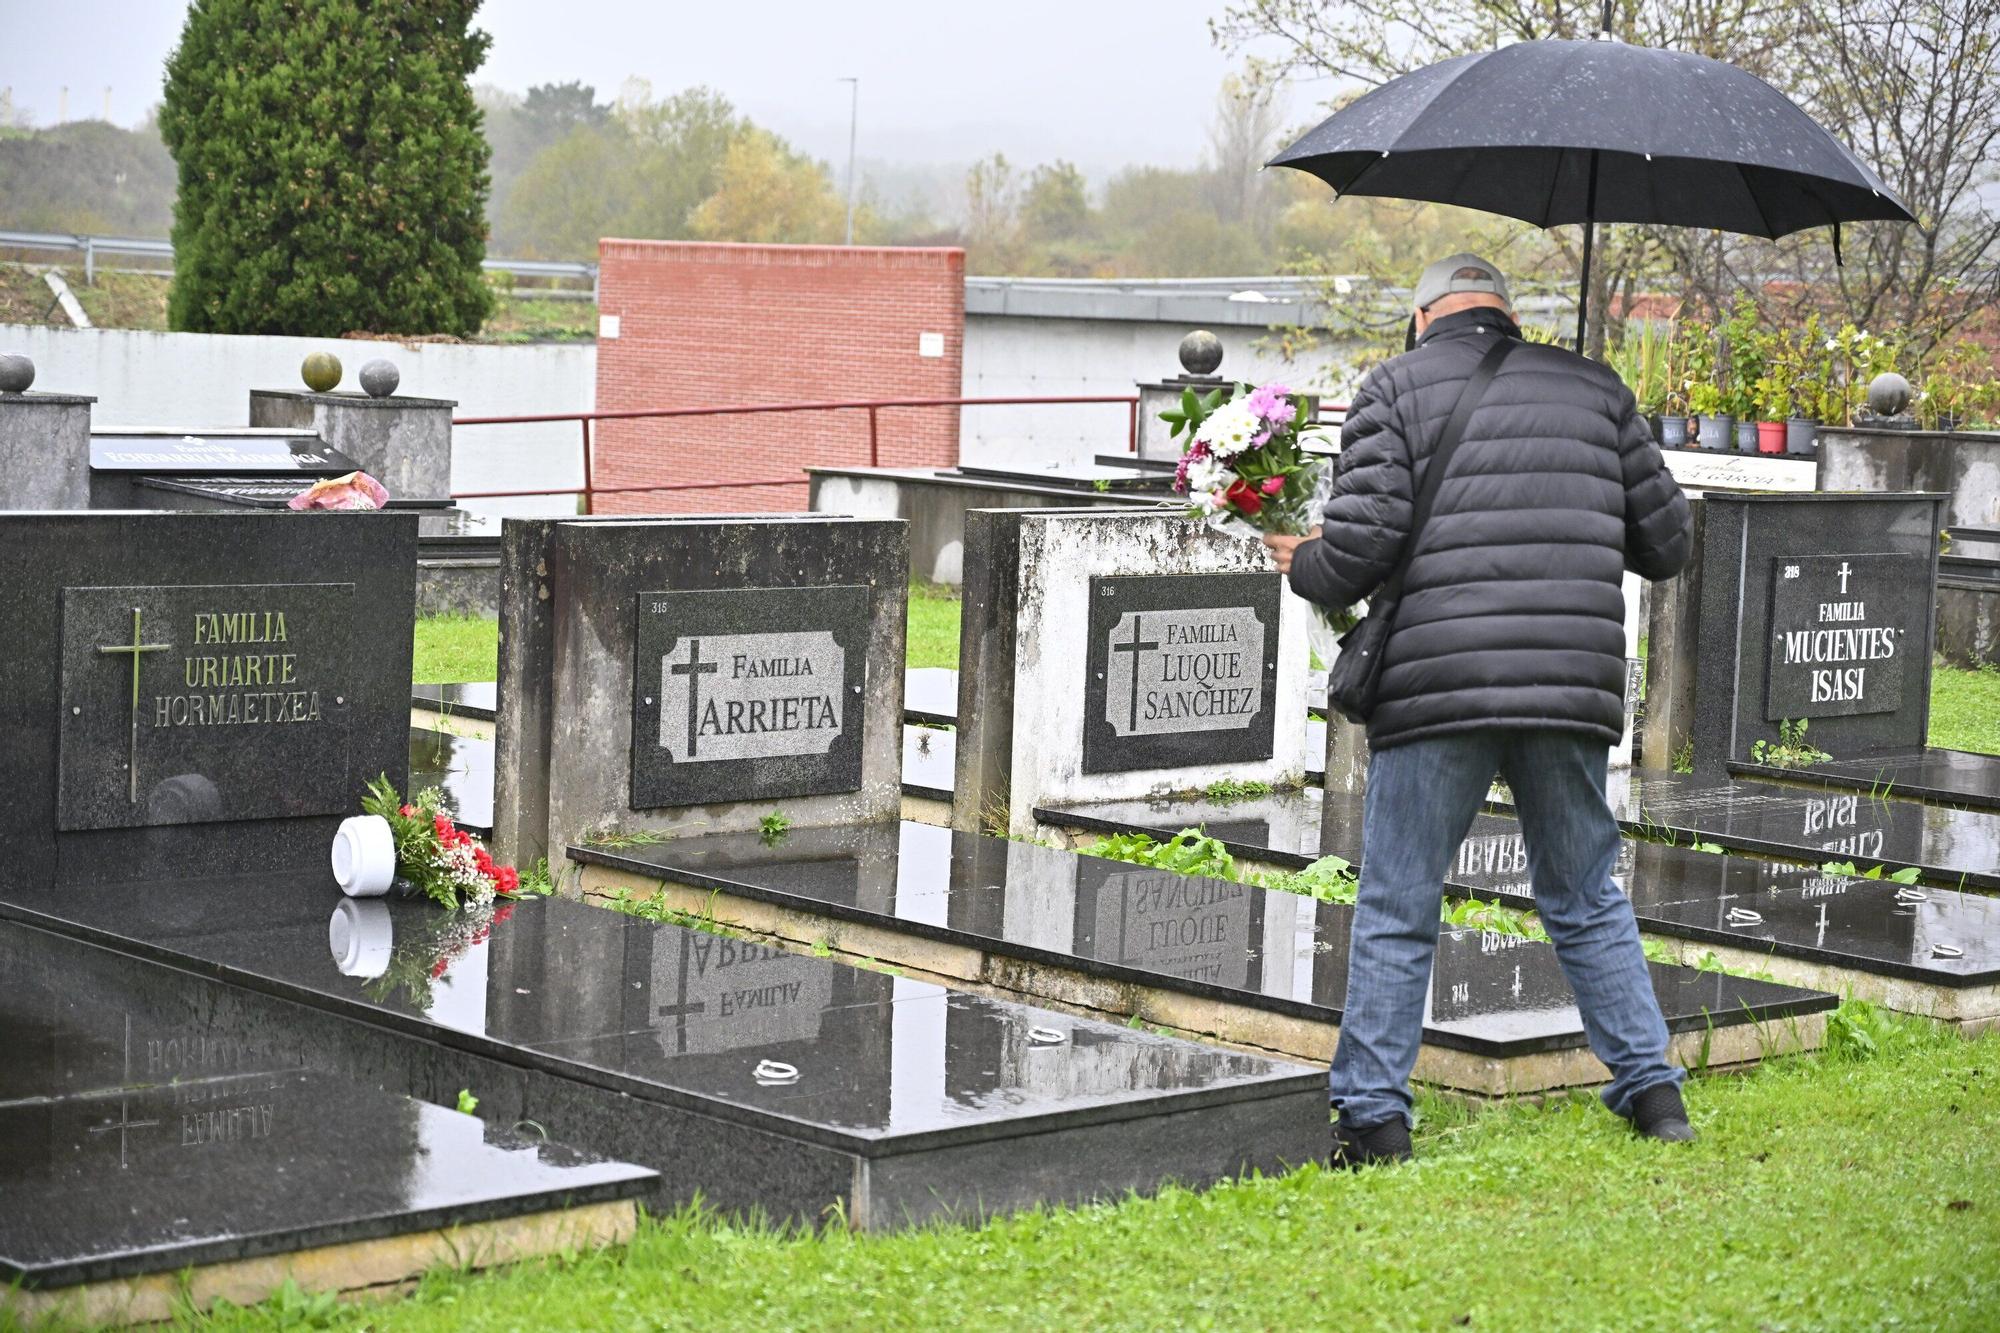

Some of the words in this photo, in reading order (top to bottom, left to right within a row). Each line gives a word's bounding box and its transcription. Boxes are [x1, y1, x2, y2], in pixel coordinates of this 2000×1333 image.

[651, 602, 668, 614] 315
[1101, 586, 1115, 597] 316
[194, 612, 288, 644] FAMILIA
[1819, 601, 1865, 622] FAMILIA
[1166, 623, 1238, 645] FAMILIA
[1784, 627, 1895, 664] MUCIENTES
[185, 653, 297, 687] URIARTE
[732, 655, 813, 679] FAMILIA
[1161, 652, 1242, 690] LUQUE
[1811, 667, 1866, 703] ISASI
[154, 691, 322, 727] HORMAETXEA
[698, 695, 838, 736] ARRIETA
[1144, 687, 1254, 720] SANCHEZ
